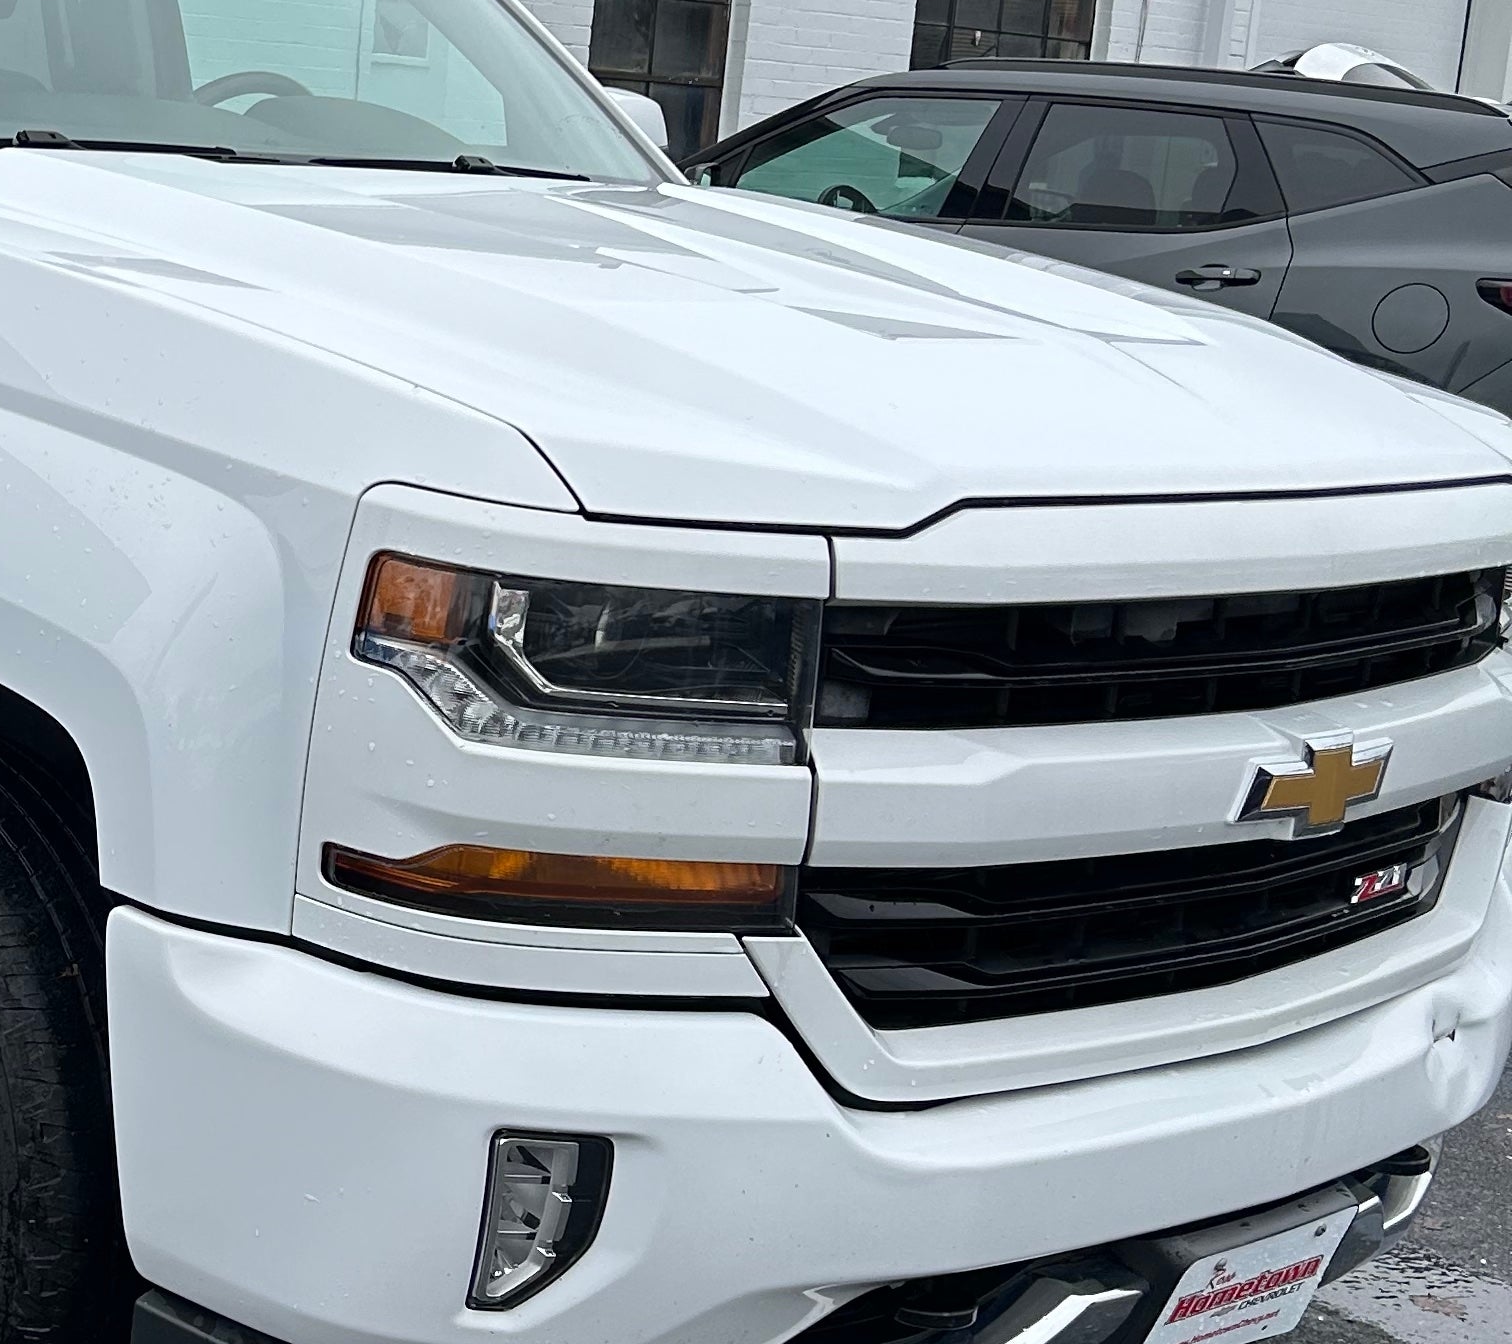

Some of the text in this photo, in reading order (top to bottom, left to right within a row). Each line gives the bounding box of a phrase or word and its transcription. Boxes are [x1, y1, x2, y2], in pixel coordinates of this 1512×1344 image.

[1350, 862, 1408, 904] Z71
[1164, 1255, 1324, 1326] Hometown
[1237, 1281, 1306, 1311] CHEVROLET
